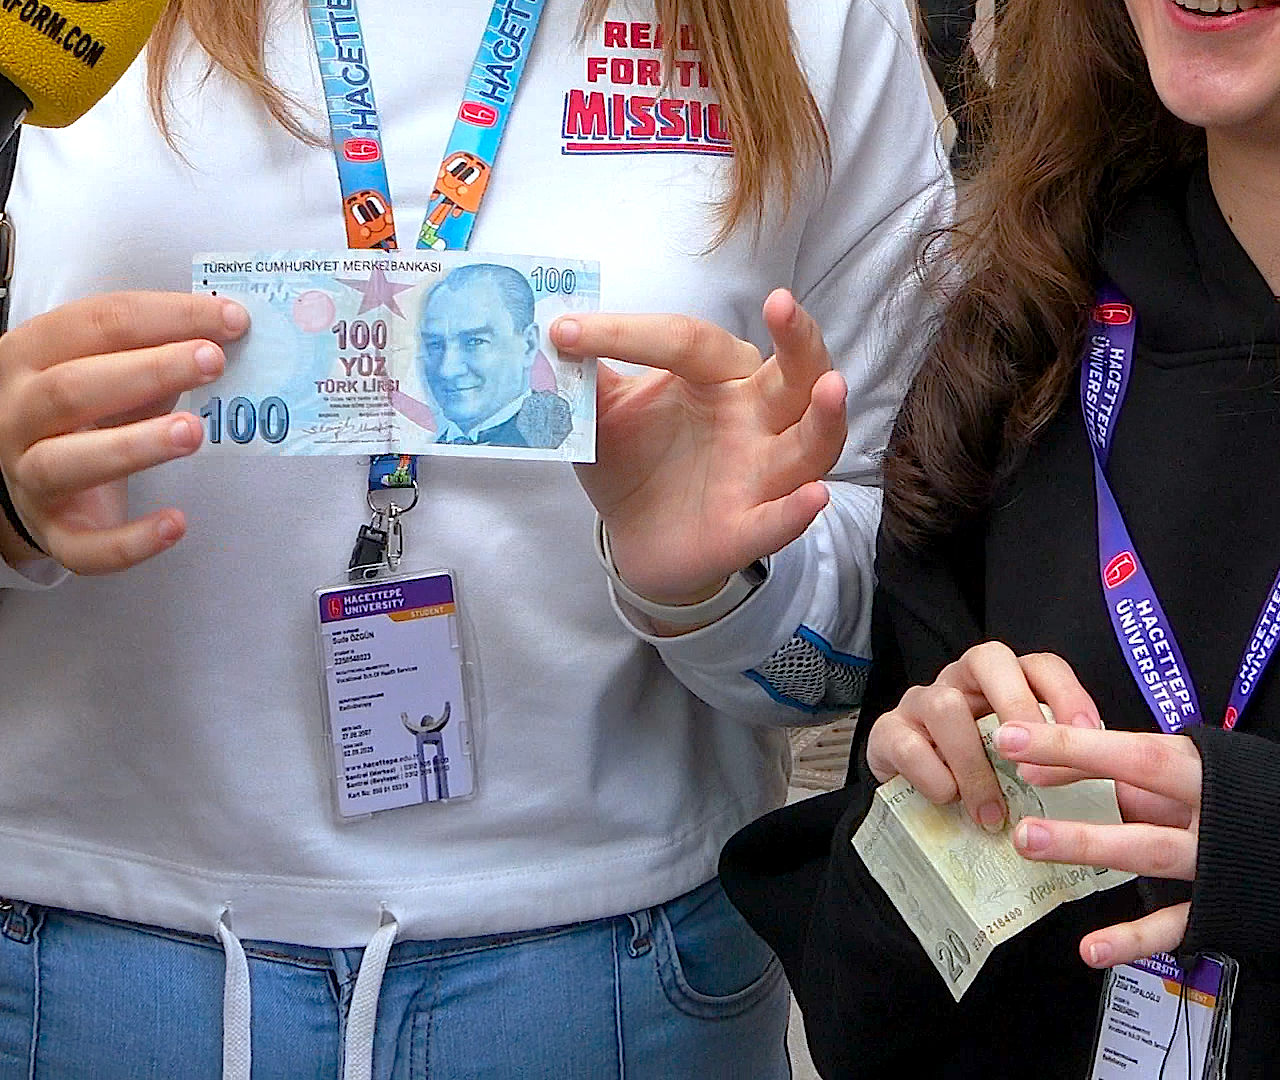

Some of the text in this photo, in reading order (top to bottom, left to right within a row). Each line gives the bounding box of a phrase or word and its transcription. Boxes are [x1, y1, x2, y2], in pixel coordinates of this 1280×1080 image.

[588, 57, 661, 87] FOR
[203, 261, 252, 274] TÜRKİYE
[255, 260, 339, 273] CUMHURİYET
[391, 261, 442, 273] BANKASI
[530, 265, 577, 295] 100
[331, 320, 388, 351] 100
[339, 352, 389, 377] YÜZ
[314, 378, 358, 394] TÜRK
[200, 395, 290, 445] 100
[343, 587, 403, 605] HACETTEPE
[344, 598, 405, 616] UNIVERSITY
[410, 606, 445, 619] STUDENT
[1114, 596, 1184, 734] ÜNİVERSİTESİ
[1135, 598, 1195, 718] HACETTEPE
[935, 928, 971, 984] 20
